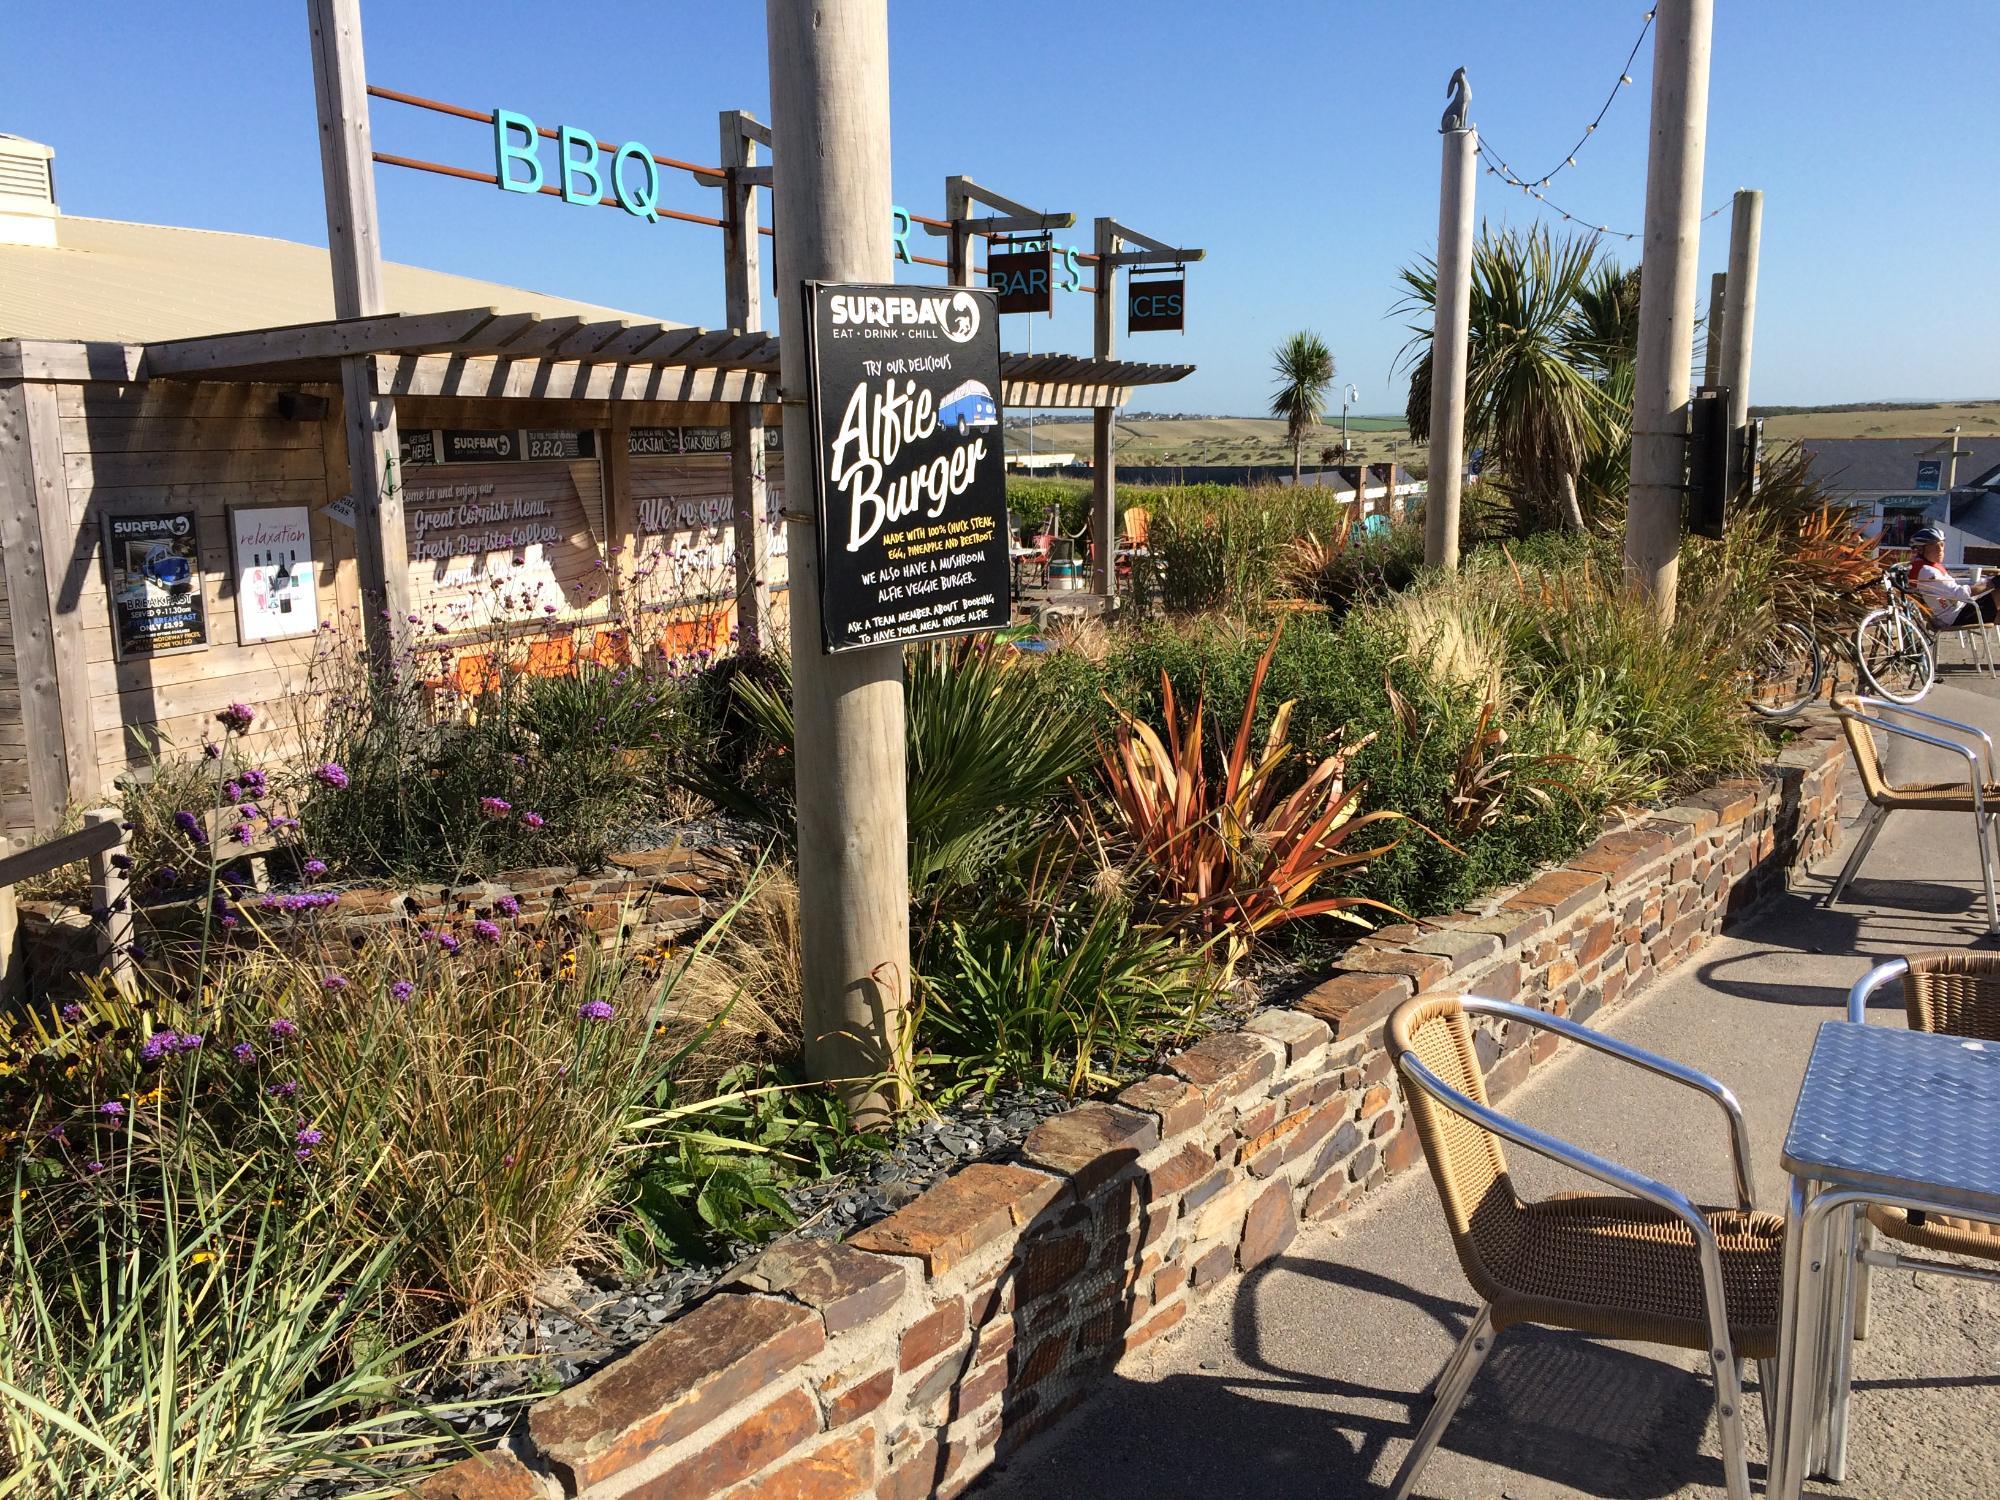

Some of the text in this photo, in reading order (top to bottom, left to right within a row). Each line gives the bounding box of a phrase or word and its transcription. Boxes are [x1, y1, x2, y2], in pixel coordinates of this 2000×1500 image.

[493, 108, 660, 223] BBQ
[991, 268, 1048, 296] BAR
[831, 294, 951, 328] SURFBAY
[1129, 294, 1182, 318] ICES
[833, 328, 938, 339] EAT DRINK CHILL
[862, 354, 951, 376] TRY OUR DELICIOUS
[831, 378, 939, 481] Alfie
[454, 437, 498, 450] SURFBAY
[531, 441, 564, 457] B.B.Q.
[629, 437, 669, 452] OCKTAIL
[402, 483, 493, 502] Come in and enjoy our
[838, 437, 987, 552] Burger
[414, 507, 456, 539] Great
[458, 501, 509, 525] Cornish
[637, 496, 696, 532] We're
[114, 520, 173, 533] SURFBAY
[240, 522, 305, 546] relaxation
[883, 516, 995, 546] MADE WITH 100% CHUCK STEAK,
[412, 532, 454, 561] Fresh
[457, 530, 508, 555] Barista
[888, 549, 906, 560] EGG,
[907, 541, 943, 557] PINEAPPLE
[945, 538, 958, 550] AND
[861, 550, 985, 585] WE ALSO HAVE A MUSHROOM
[878, 571, 977, 603] ALFIE VEGGIE BURGER.
[127, 593, 192, 610] BREAKFAST
[131, 609, 154, 618] SERVED
[847, 593, 994, 634] ASK A TEAM MEMBER ABOUT BOOKING
[140, 623, 161, 632] ONLY
[153, 613, 197, 624] BREAKFAST
[859, 609, 989, 644] TO HAVE YOUR MEAL INSIDE ALFIE
